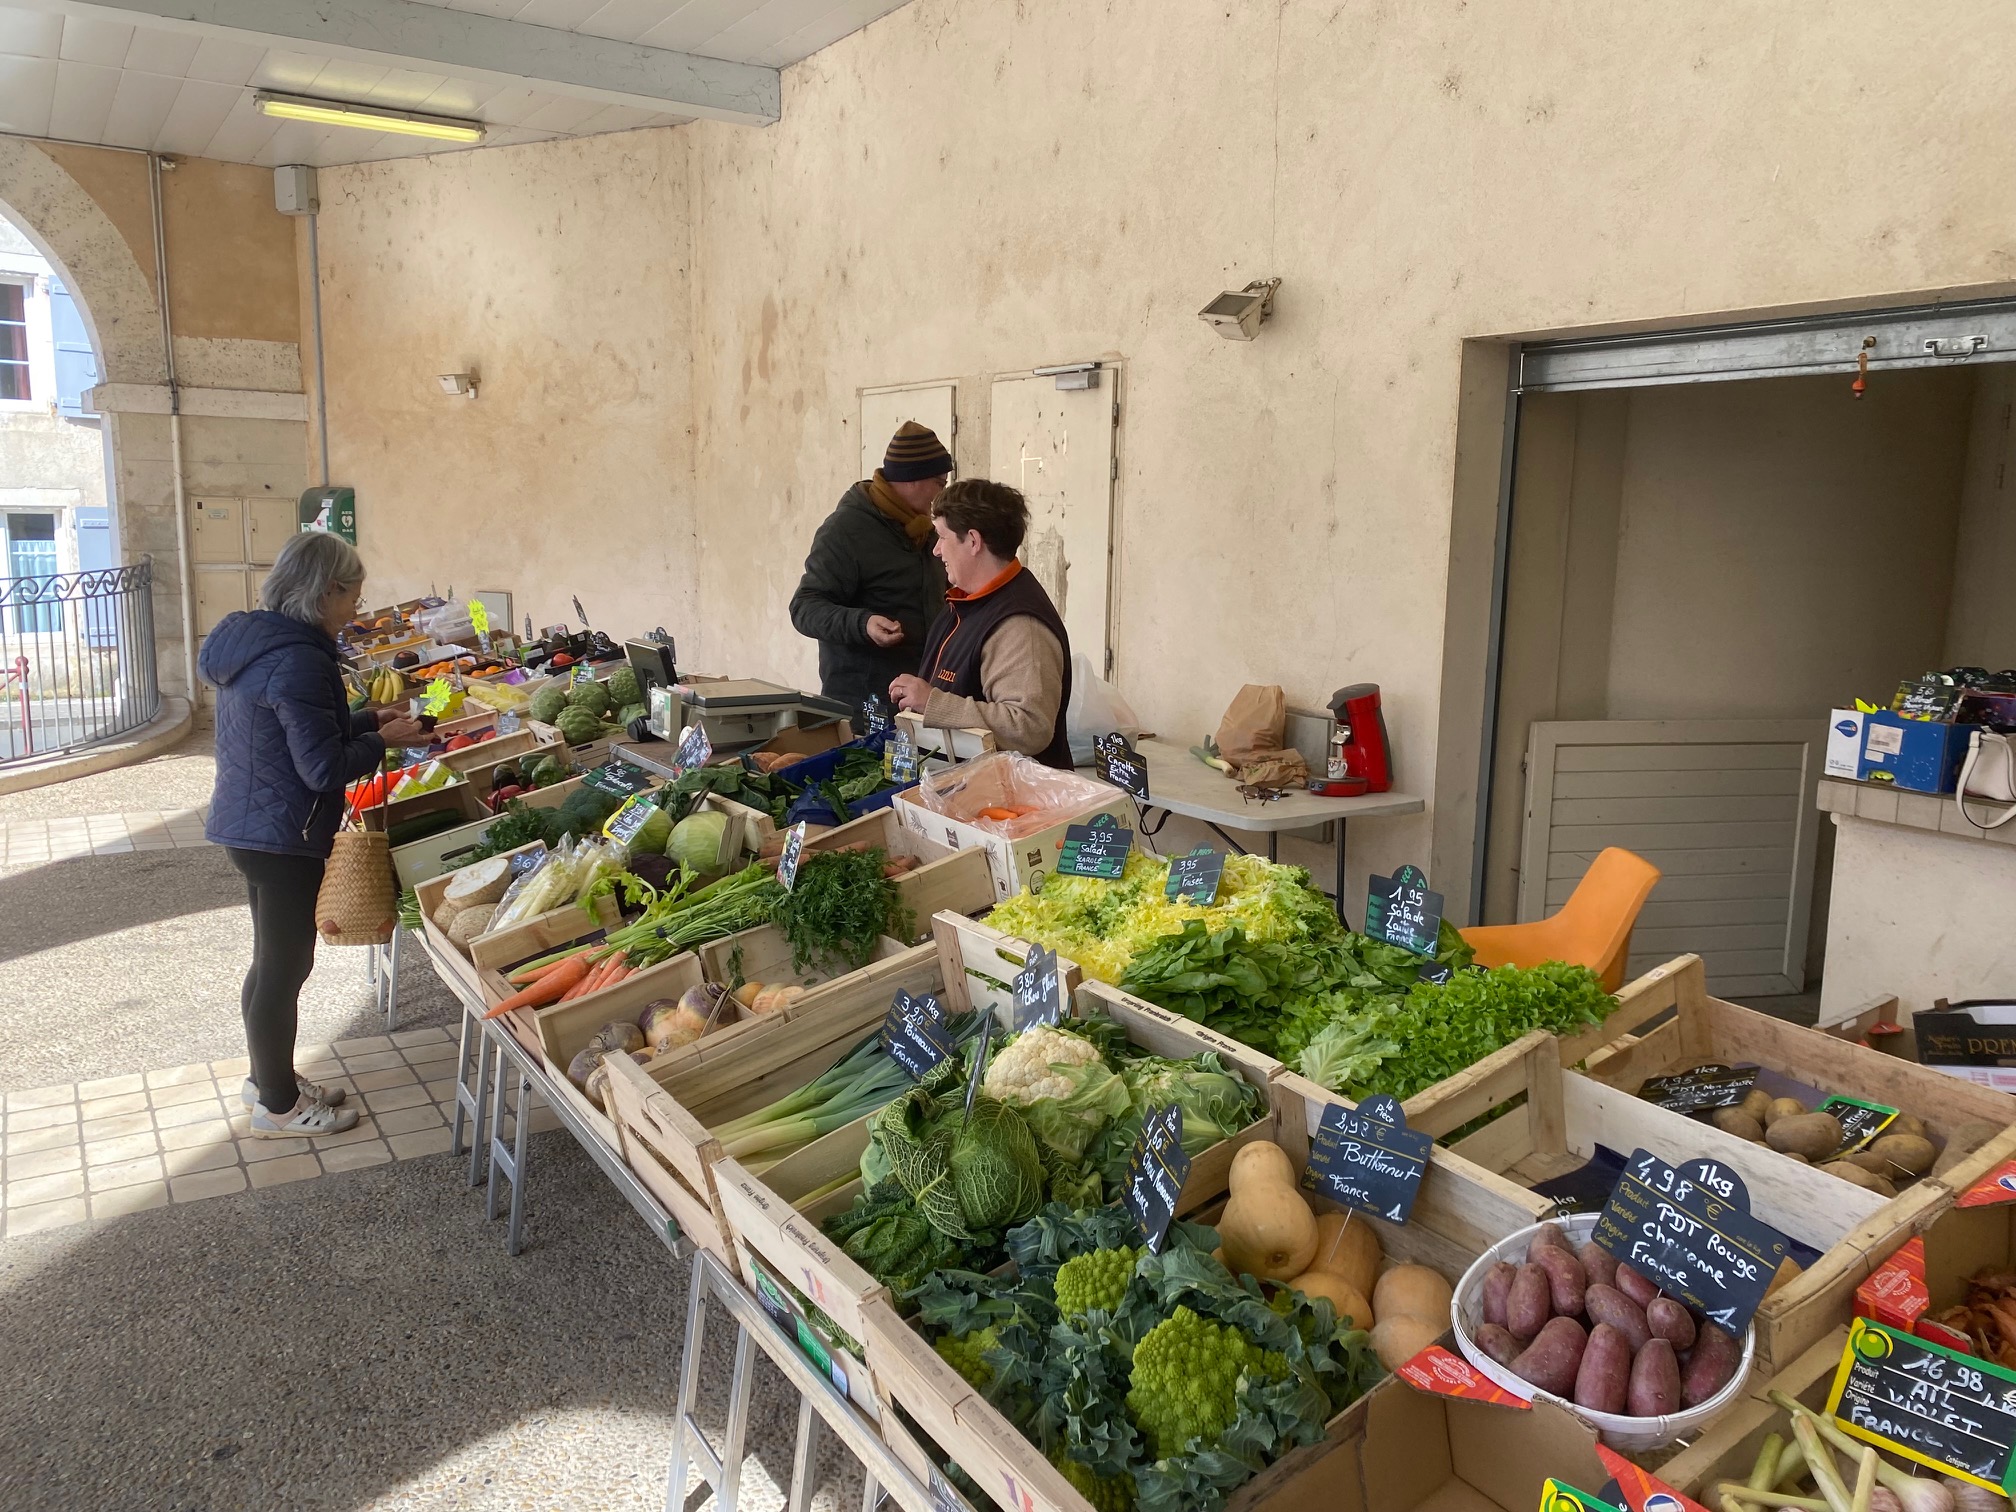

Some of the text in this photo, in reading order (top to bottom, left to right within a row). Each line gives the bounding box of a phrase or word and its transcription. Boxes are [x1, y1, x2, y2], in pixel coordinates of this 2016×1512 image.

[1089, 831, 1113, 844] 3,95
[926, 998, 940, 1020] 1kg
[1329, 1174, 1370, 1202] France
[1699, 1165, 1734, 1198] 1kg
[1656, 1202, 1702, 1237] PDT
[1706, 1234, 1757, 1282] Rouge
[1630, 1241, 1688, 1287] France
[1706, 1306, 1738, 1332] 1
[1845, 1390, 1870, 1407] Origine
[1850, 1376, 1876, 1394] Variété
[1854, 1362, 1955, 1411] Produit AIL
[1851, 1406, 1944, 1448] FRANCE
[1946, 1454, 1971, 1470] Catégorie
